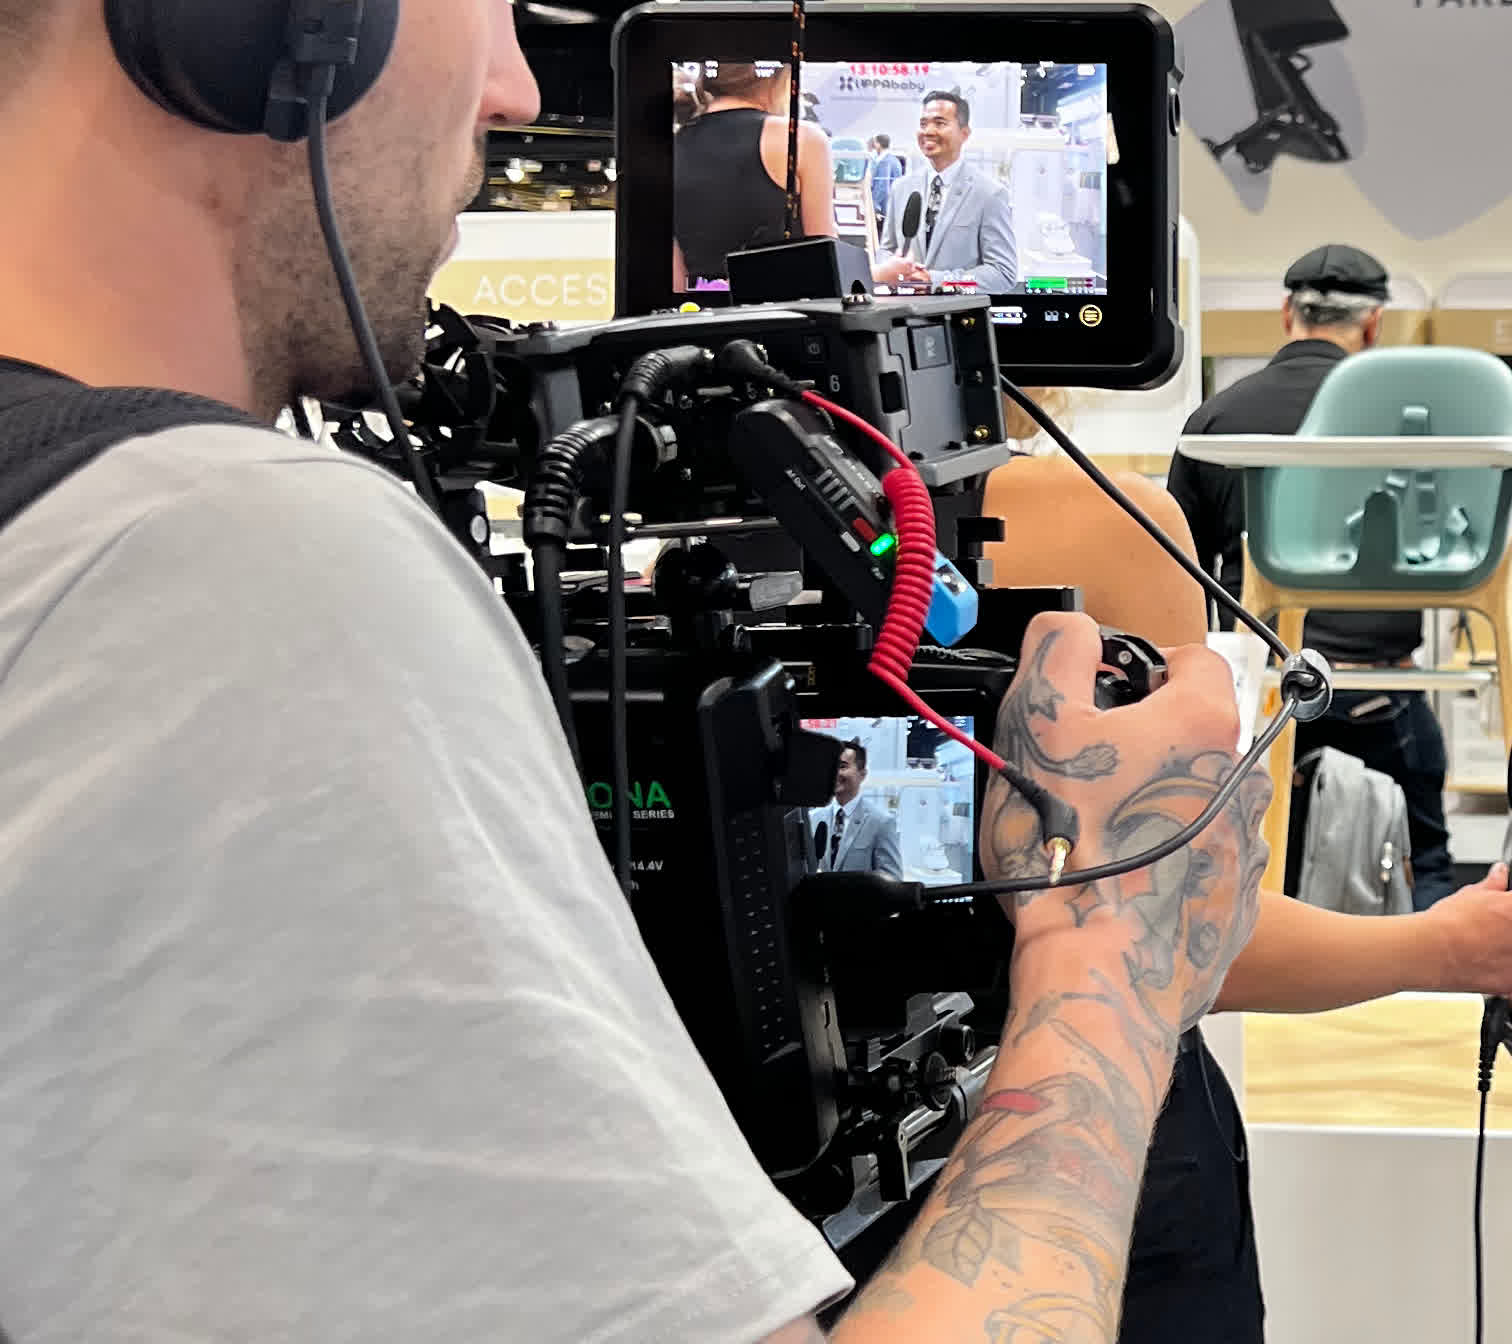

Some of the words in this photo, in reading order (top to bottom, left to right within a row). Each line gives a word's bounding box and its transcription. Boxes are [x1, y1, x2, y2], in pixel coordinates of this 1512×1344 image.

[472, 272, 608, 306] ACCES
[830, 375, 841, 392] 6
[632, 809, 675, 819] SERIES
